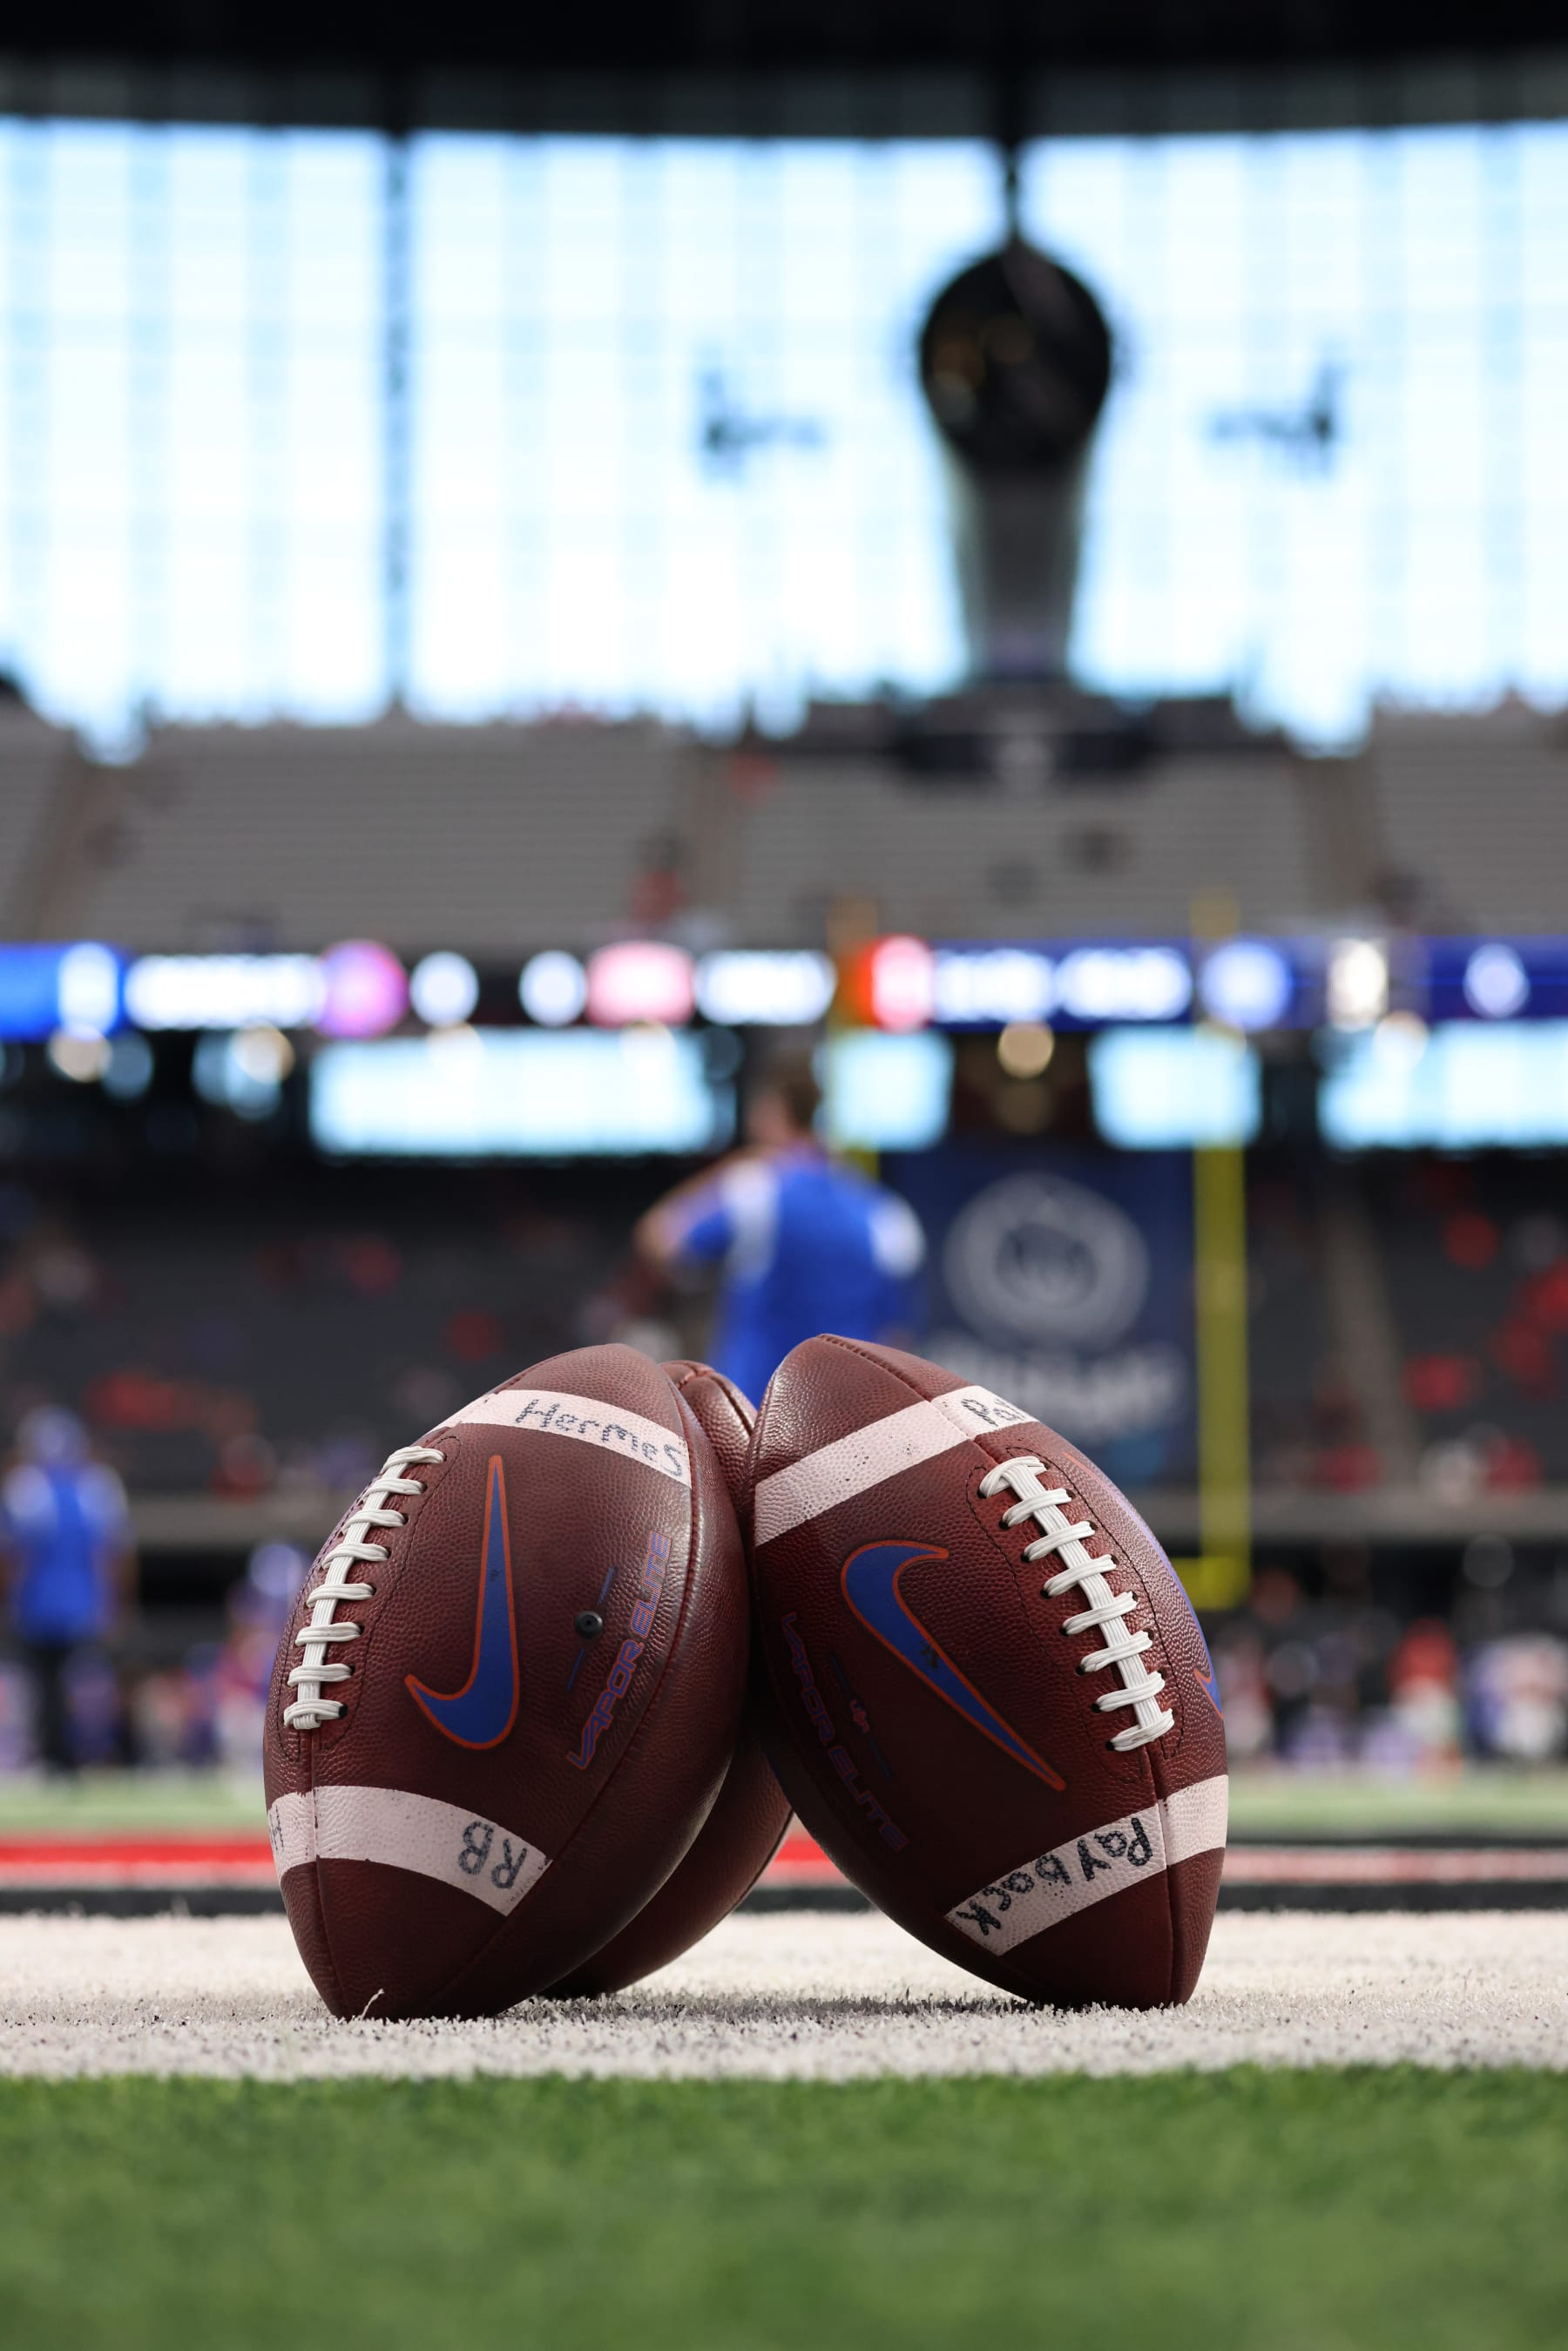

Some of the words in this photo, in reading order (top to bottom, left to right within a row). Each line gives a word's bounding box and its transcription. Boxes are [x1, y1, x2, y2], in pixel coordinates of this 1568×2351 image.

[566, 1638, 645, 1770] VAPOR
[629, 1530, 672, 1639] ELITE
[782, 1611, 835, 1746] VAPOR
[828, 1745, 909, 1853] ELITE
[457, 1821, 528, 1889] RB
